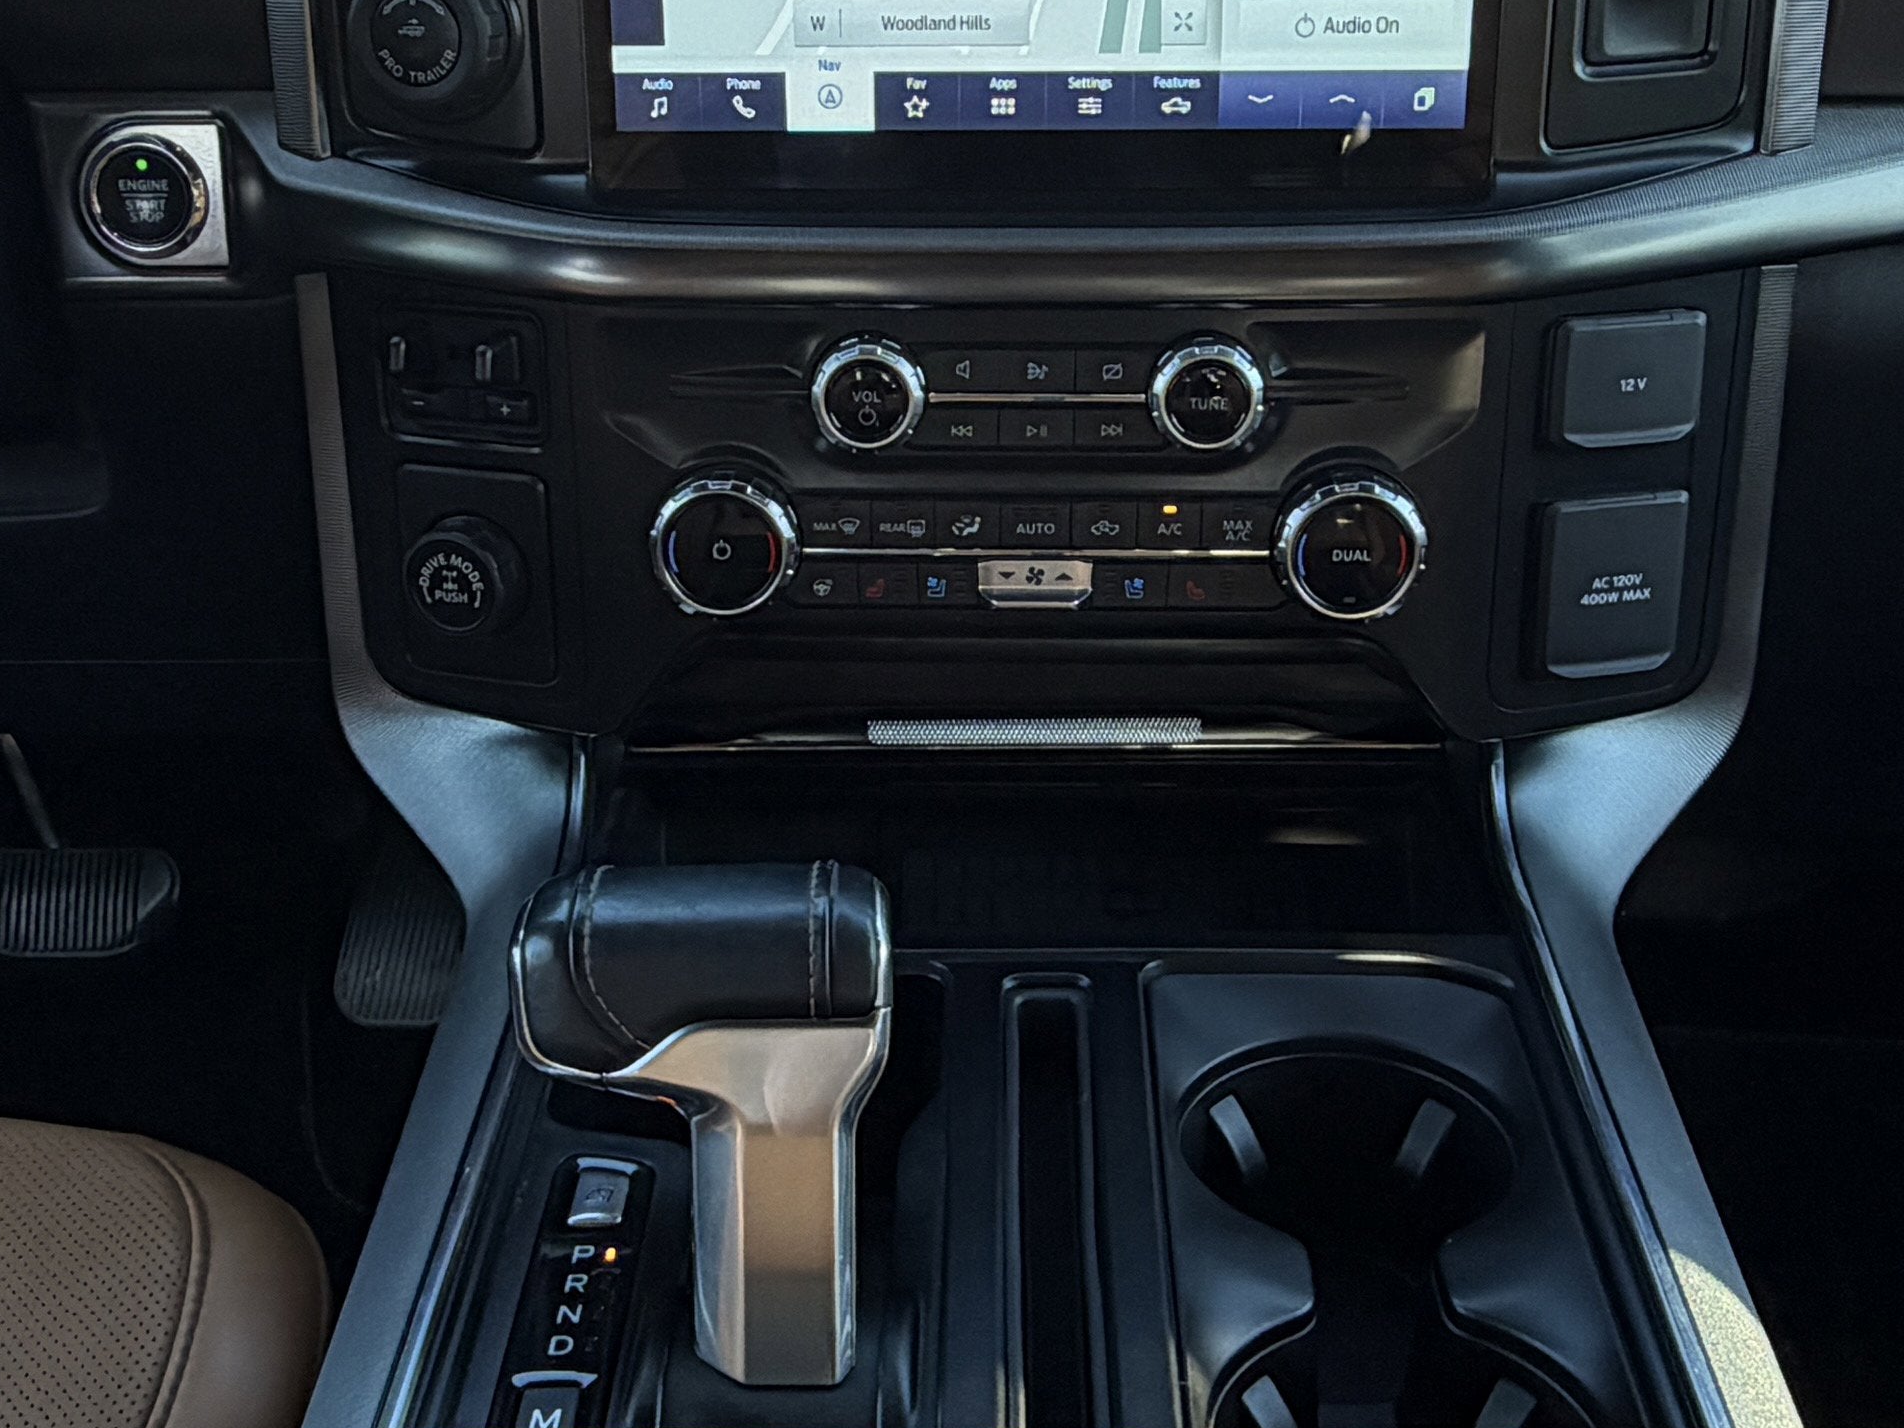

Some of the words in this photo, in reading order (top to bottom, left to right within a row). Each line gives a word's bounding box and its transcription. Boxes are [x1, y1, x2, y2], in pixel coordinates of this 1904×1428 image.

[809, 16, 826, 32] W
[881, 14, 956, 33] Woodland
[959, 13, 992, 33] Hills
[1323, 16, 1372, 36] Audio
[1376, 16, 1400, 35] On
[376, 46, 405, 79] PRO
[408, 47, 459, 85] TRAILER
[818, 59, 842, 72] Nav
[642, 77, 674, 91] Audio
[726, 77, 761, 91] Phone
[906, 76, 928, 90] Fav
[989, 77, 1017, 93] Apps
[1068, 76, 1113, 93] Settings
[1153, 76, 1201, 90] Features
[118, 178, 170, 192] ENGINE
[124, 197, 166, 213] START
[129, 210, 165, 224] STOP
[853, 391, 882, 404] VOL
[1189, 397, 1229, 412] TUNE
[879, 521, 908, 533] REAR
[1015, 522, 1056, 536] AUTO
[1156, 522, 1183, 536] A/C
[1222, 519, 1254, 531] MAX
[1225, 529, 1251, 542] A/C
[1332, 549, 1372, 563] DUAL
[418, 552, 448, 588] DRIVE
[449, 553, 485, 592] MODE
[1592, 577, 1611, 590] AC
[1612, 573, 1644, 588] 120V
[434, 589, 469, 605] PUSH
[1580, 590, 1621, 606] 400W
[1622, 586, 1652, 602] MAX
[571, 1244, 596, 1265] P
[563, 1273, 589, 1294] R
[556, 1303, 584, 1325] N
[546, 1334, 575, 1357] D
